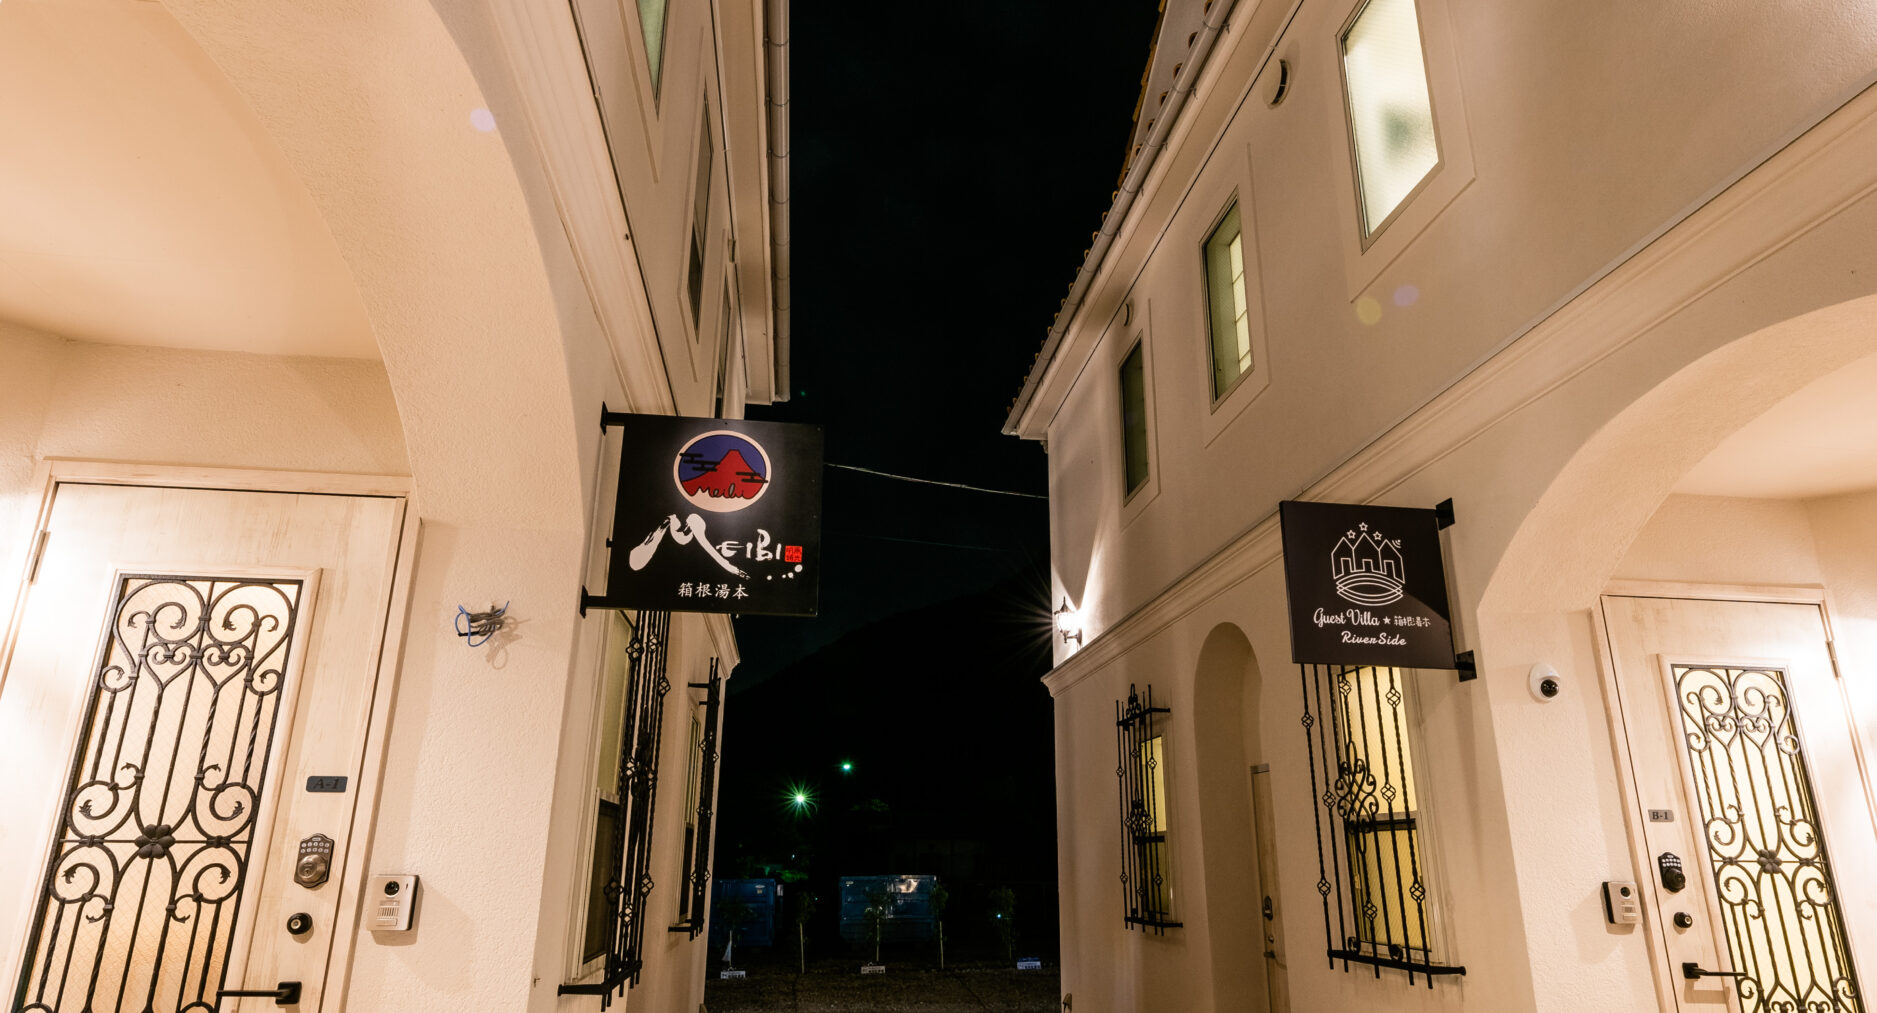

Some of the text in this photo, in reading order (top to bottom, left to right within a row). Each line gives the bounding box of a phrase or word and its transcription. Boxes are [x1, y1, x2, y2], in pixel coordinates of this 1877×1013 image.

[629, 513, 782, 579] MEIBI
[678, 582, 749, 599] 箱根湯本
[1313, 607, 1346, 627] Guest
[1346, 609, 1380, 626] Villa
[313, 779, 340, 790] A-1
[1652, 811, 1668, 820] B-1
